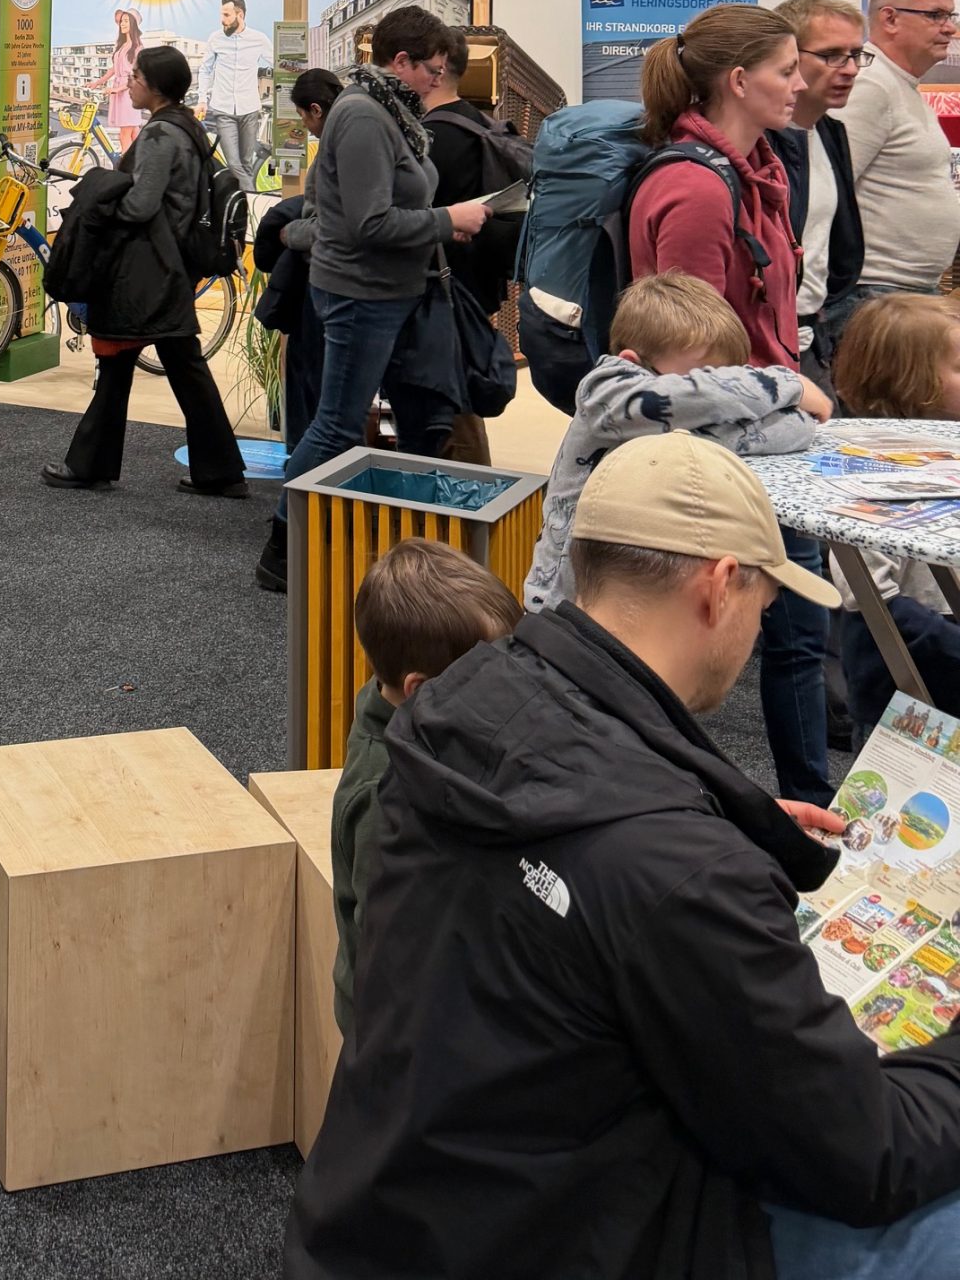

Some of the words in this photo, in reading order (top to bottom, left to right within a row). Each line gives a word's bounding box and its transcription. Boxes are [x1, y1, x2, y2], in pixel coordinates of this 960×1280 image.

[586, 21, 603, 32] IHR
[605, 22, 676, 34] STRANDKORB
[602, 45, 640, 56] DIREKT
[519, 857, 555, 892] NORTH
[537, 860, 558, 883] THE
[522, 874, 550, 902] FACE
